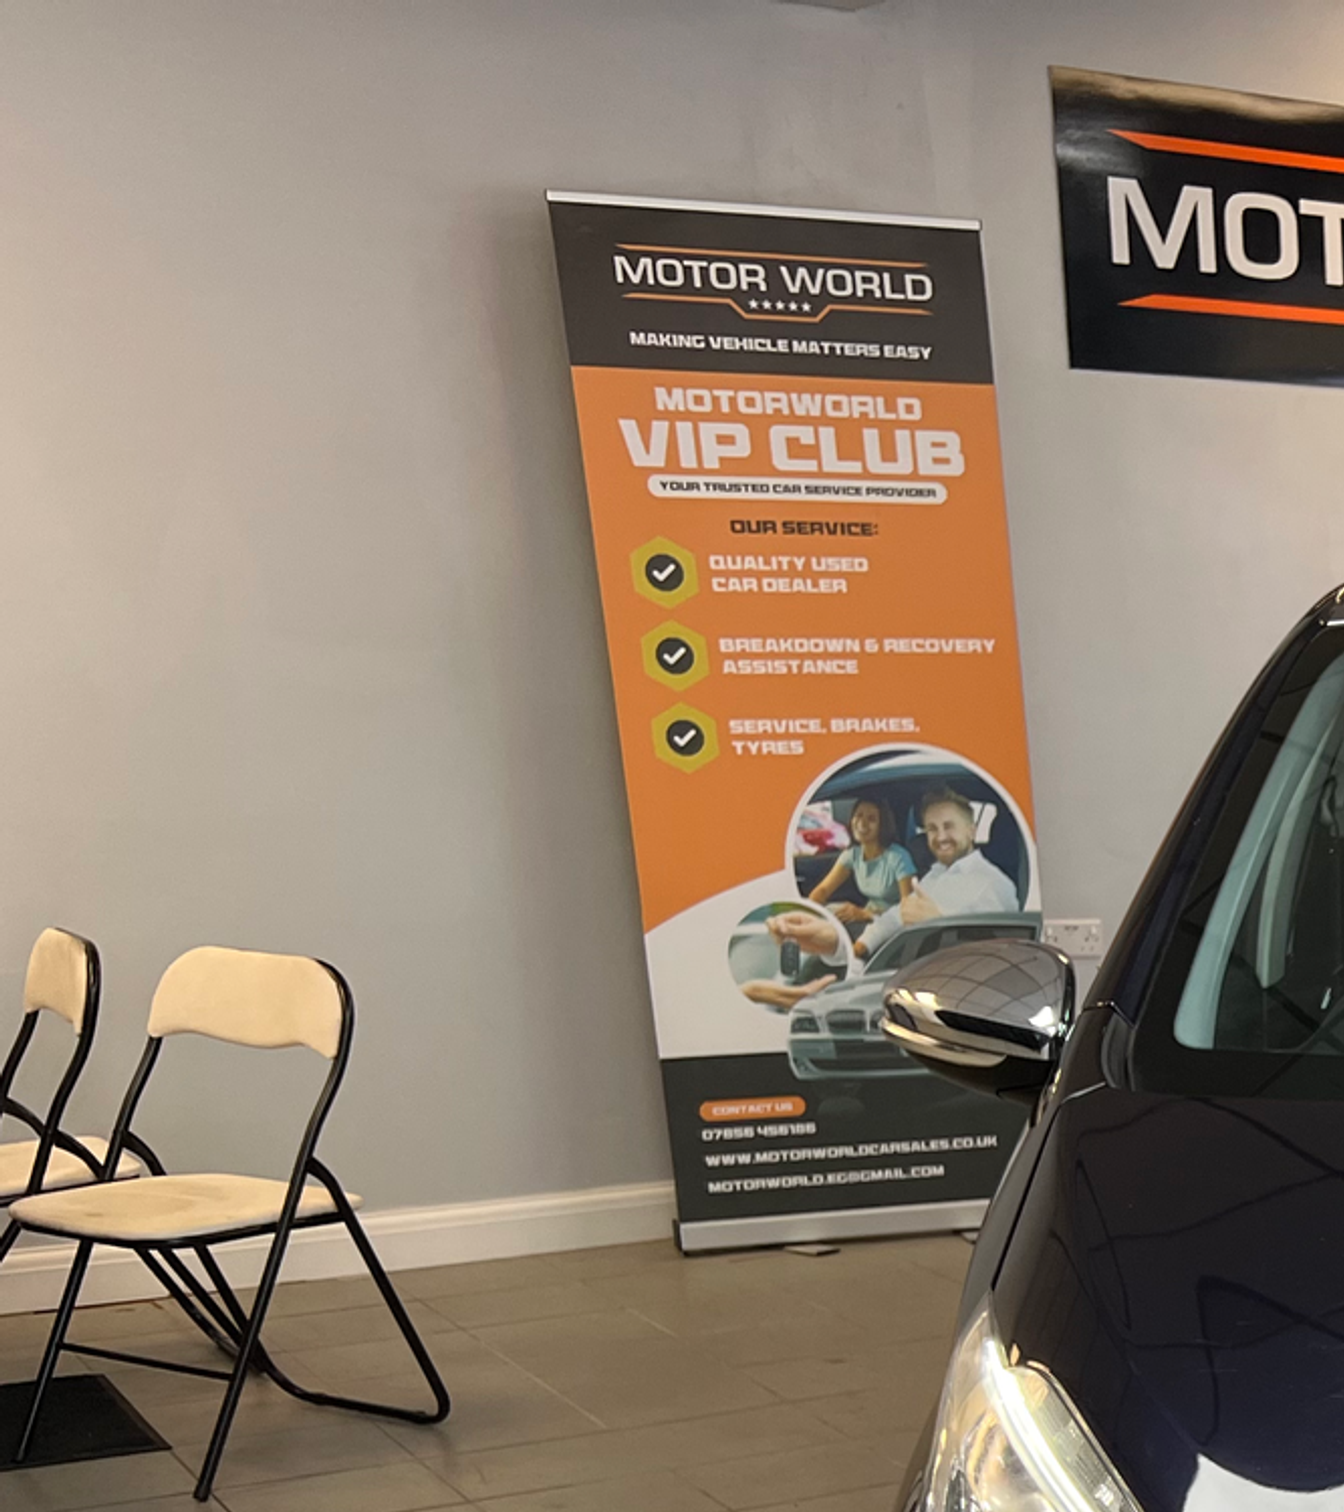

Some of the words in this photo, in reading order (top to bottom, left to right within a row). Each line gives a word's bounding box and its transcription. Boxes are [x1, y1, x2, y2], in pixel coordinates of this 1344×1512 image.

[613, 256, 767, 292] MOTOR
[780, 265, 933, 301] WORLD
[629, 331, 705, 349] MAKING
[708, 336, 789, 353] VEHICLE
[792, 341, 881, 358] MATTERS
[883, 345, 932, 360] EASY
[654, 386, 923, 420] MOTORWORLD
[618, 418, 751, 469] VIP
[770, 424, 966, 477] CLUB
[660, 480, 701, 492] YOUR
[703, 482, 770, 494] TRUSTED
[772, 484, 802, 495] CAR
[804, 485, 864, 497] SERVICE
[865, 487, 937, 498] PROVIDER
[730, 519, 778, 535] OUR
[782, 520, 879, 537] SERVICE:
[708, 555, 806, 572] QUALITY
[811, 556, 869, 572] USED
[711, 577, 759, 592] CAR
[761, 578, 848, 593] DEALER
[718, 638, 861, 653] BREAKDOWN
[864, 638, 879, 653] &
[883, 638, 996, 654] RECOVERY
[722, 659, 859, 675] ASSISTANCE
[731, 739, 805, 755] TYRES
[711, 1102, 773, 1116] CONTACT
[774, 1101, 794, 1113] US
[705, 1134, 998, 1168] WWW.MOTORWORLDCARSALES.CO.UK
